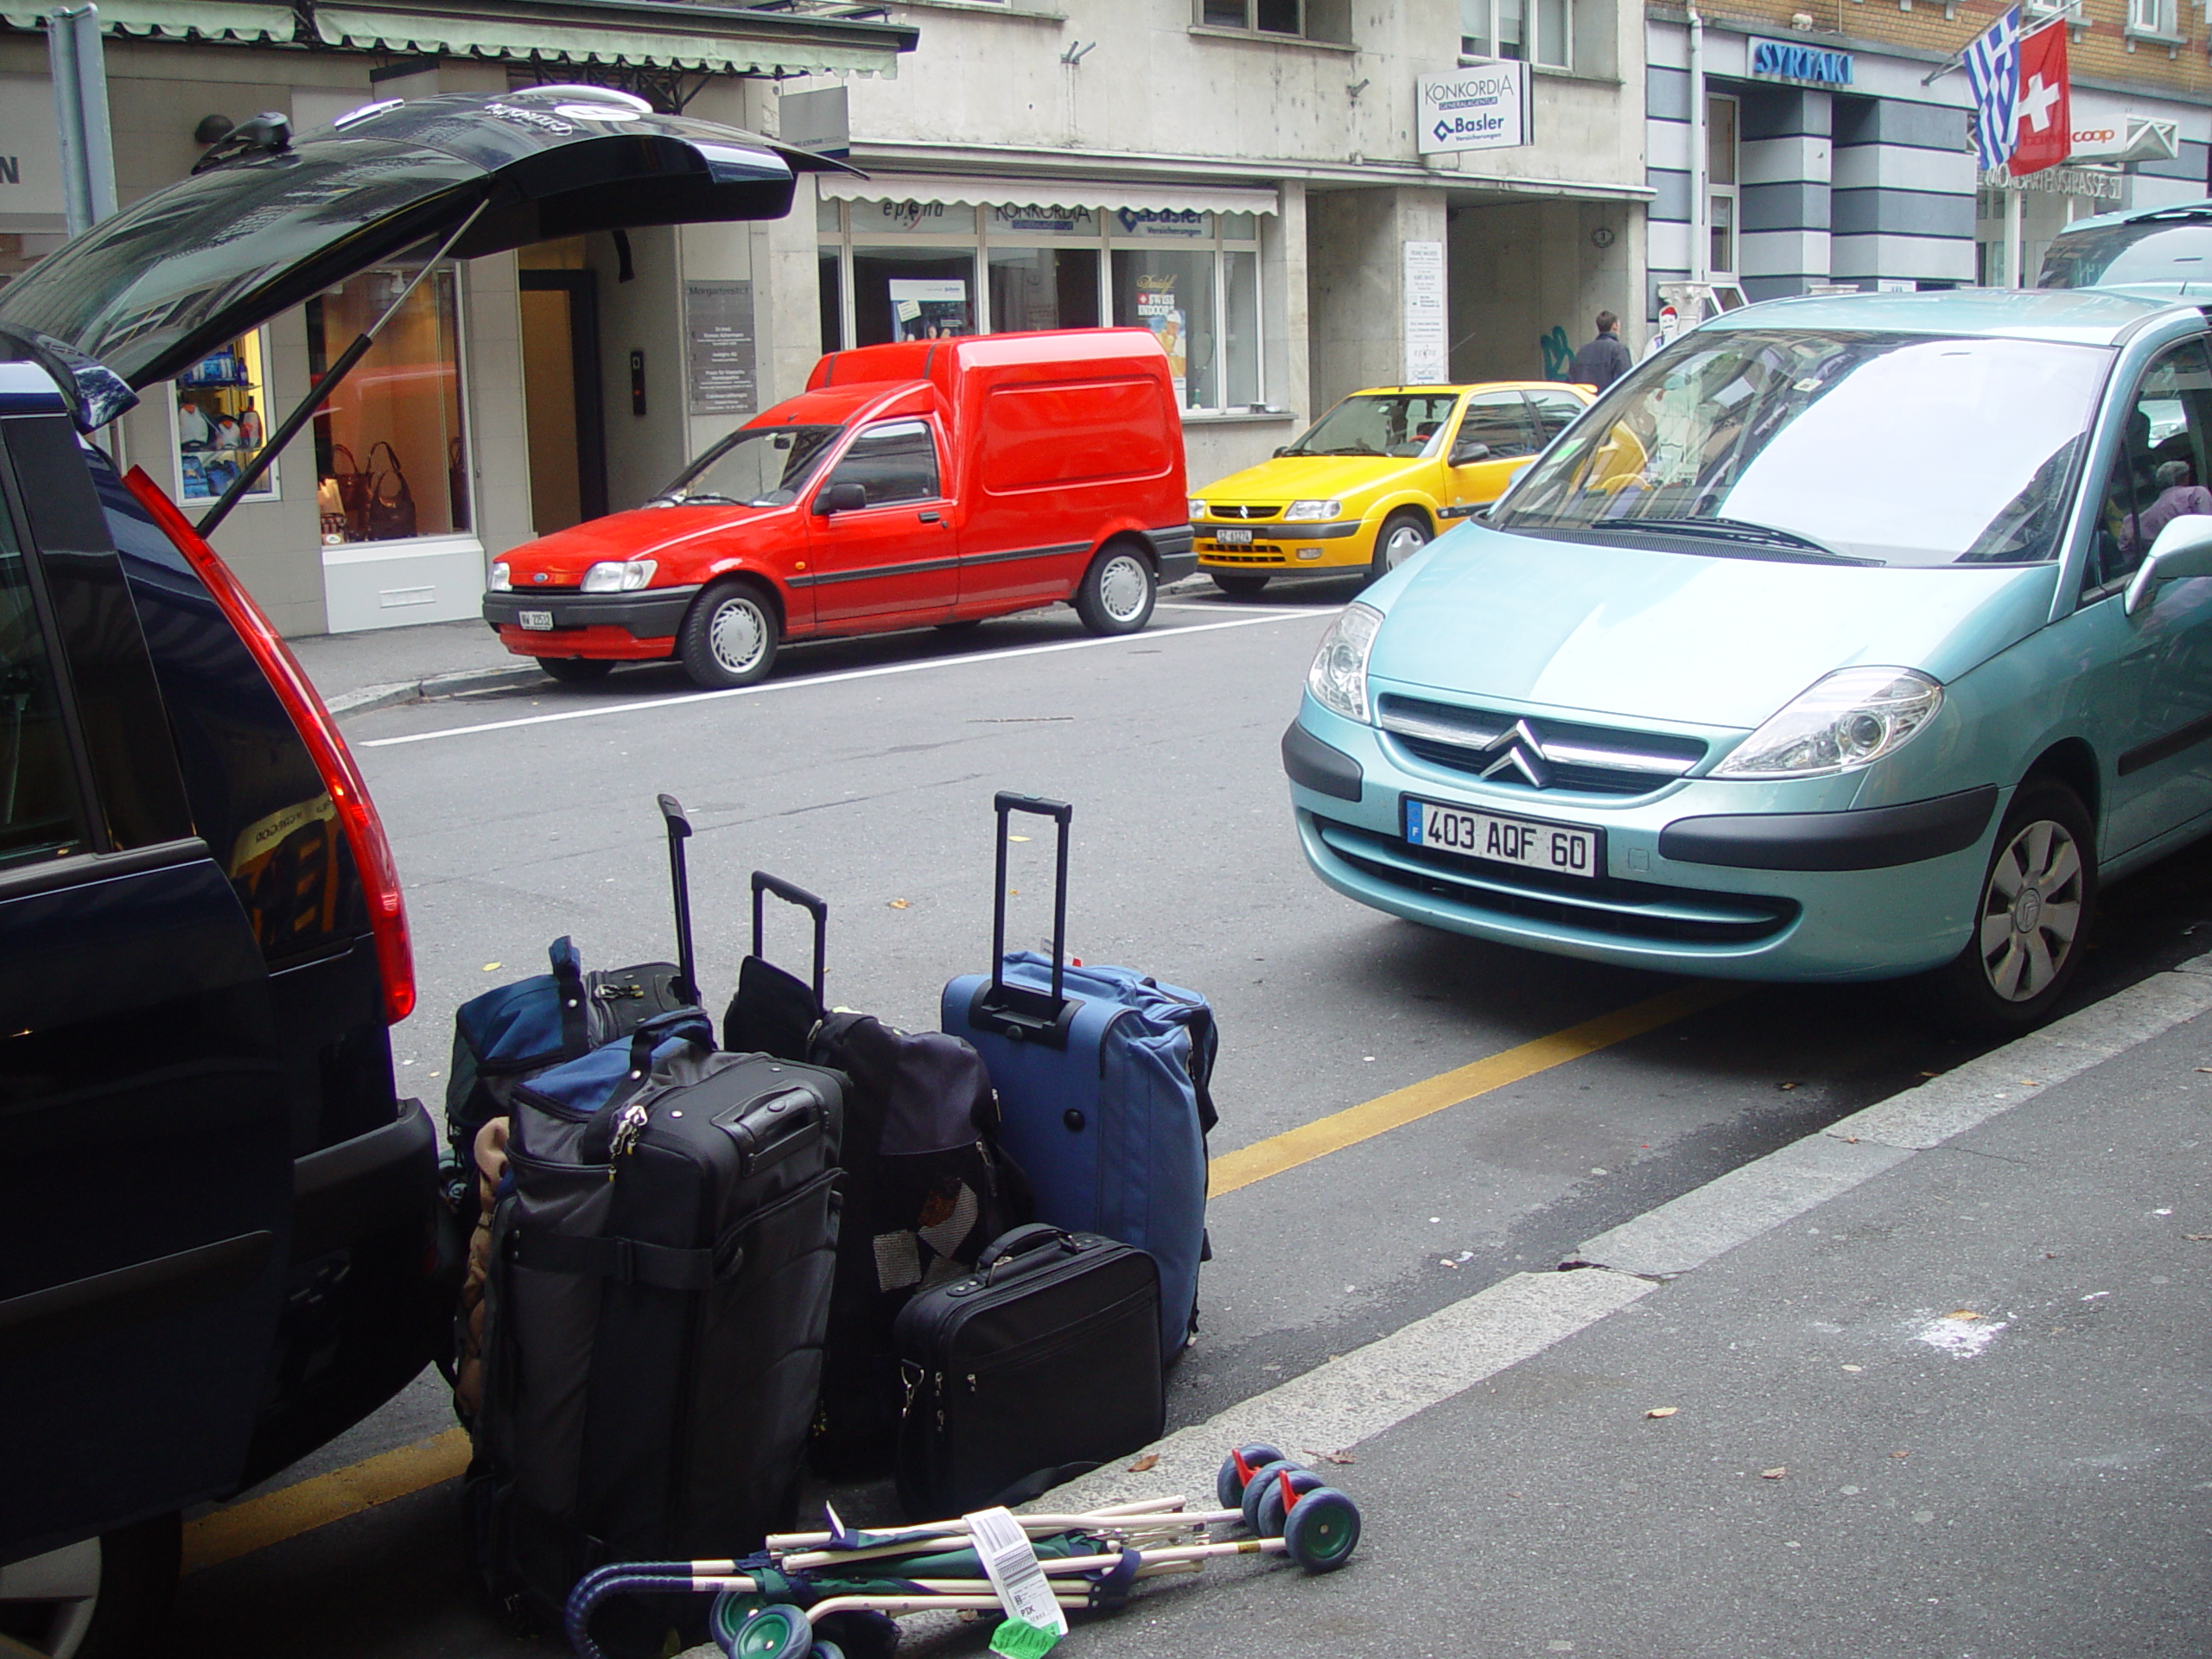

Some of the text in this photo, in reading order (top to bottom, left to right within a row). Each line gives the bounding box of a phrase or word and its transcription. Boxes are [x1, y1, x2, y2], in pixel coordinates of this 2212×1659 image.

[1754, 41, 1853, 85] SYRTAKI
[1425, 74, 1515, 105] KONKORDIA
[1454, 113, 1504, 133] Basler
[1455, 133, 1502, 142] Versicherungen
[2073, 130, 2114, 143] coop
[1412, 826, 1419, 836] F
[1428, 811, 1586, 869] 403 AQF 60
